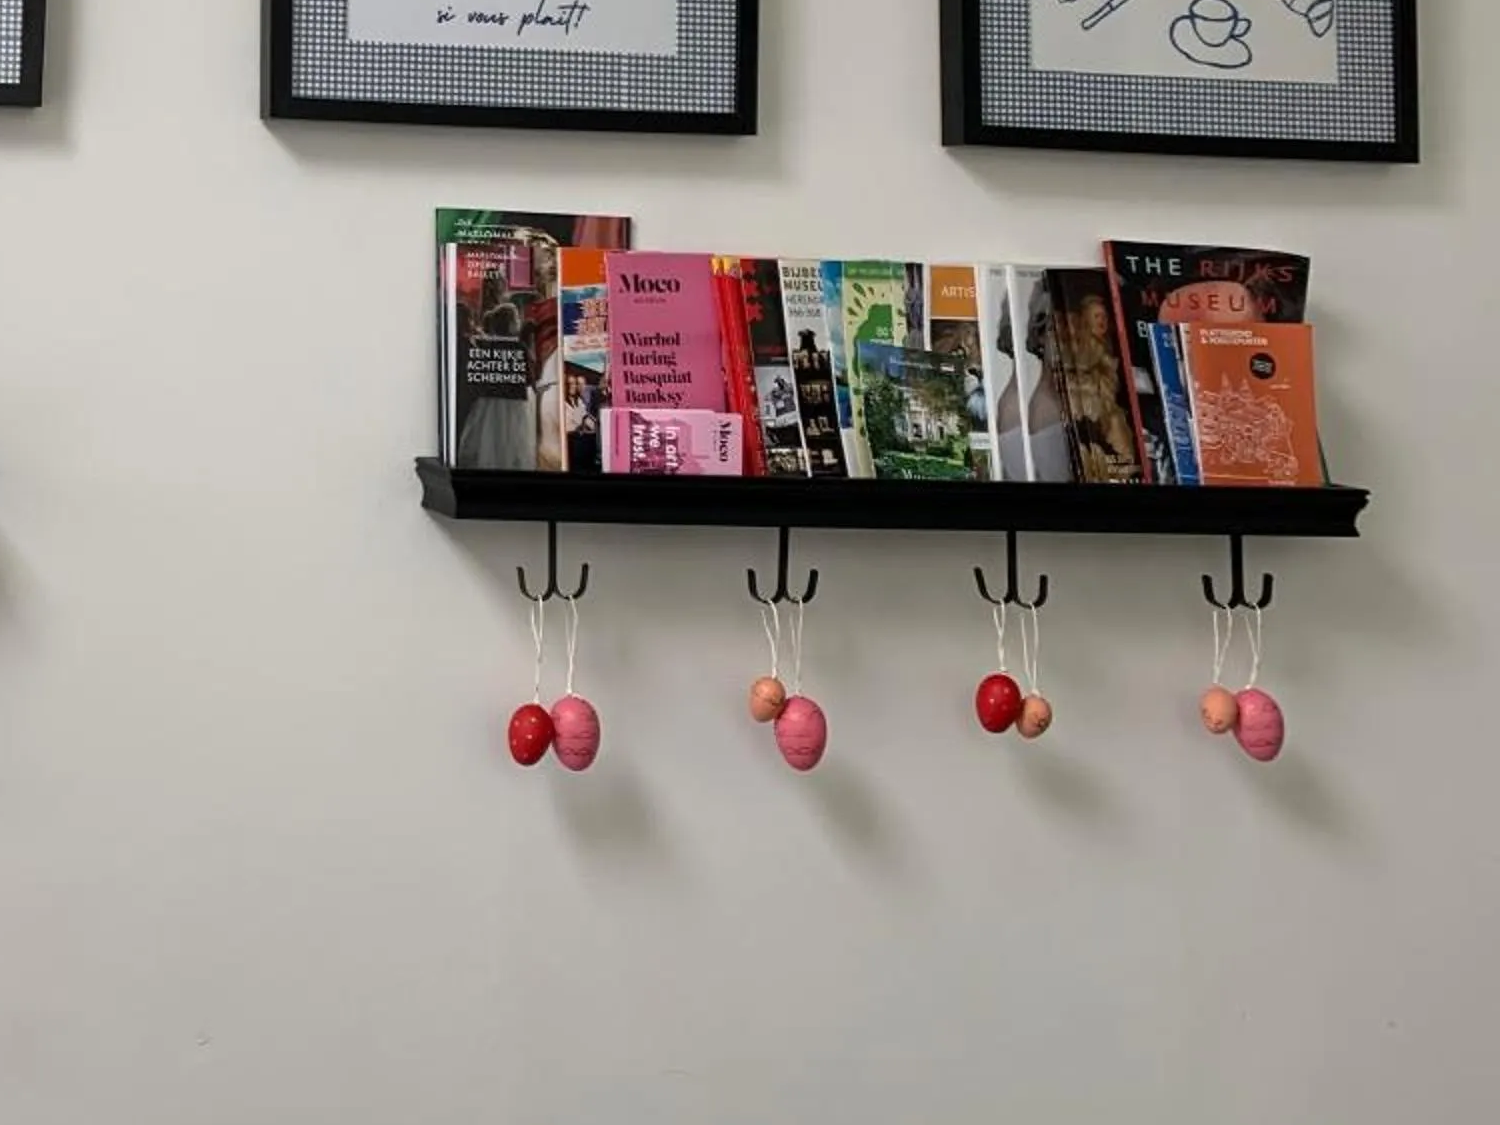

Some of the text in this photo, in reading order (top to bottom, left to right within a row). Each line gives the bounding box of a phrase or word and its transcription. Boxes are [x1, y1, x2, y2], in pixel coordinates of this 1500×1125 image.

[436, 6, 455, 24] si
[467, 12, 509, 26] vous
[1125, 255, 1294, 283] THE RIJKS
[619, 273, 681, 294] Moco
[1140, 290, 1278, 315] MUSEUM
[621, 332, 681, 347] Warhol
[468, 348, 491, 360] EEN
[622, 351, 677, 367] Haring
[466, 360, 510, 372] ACHTER
[466, 372, 527, 385] SCHERMEN
[623, 370, 692, 387] Basquiat
[625, 389, 685, 408] Banksy
[648, 424, 660, 449] we
